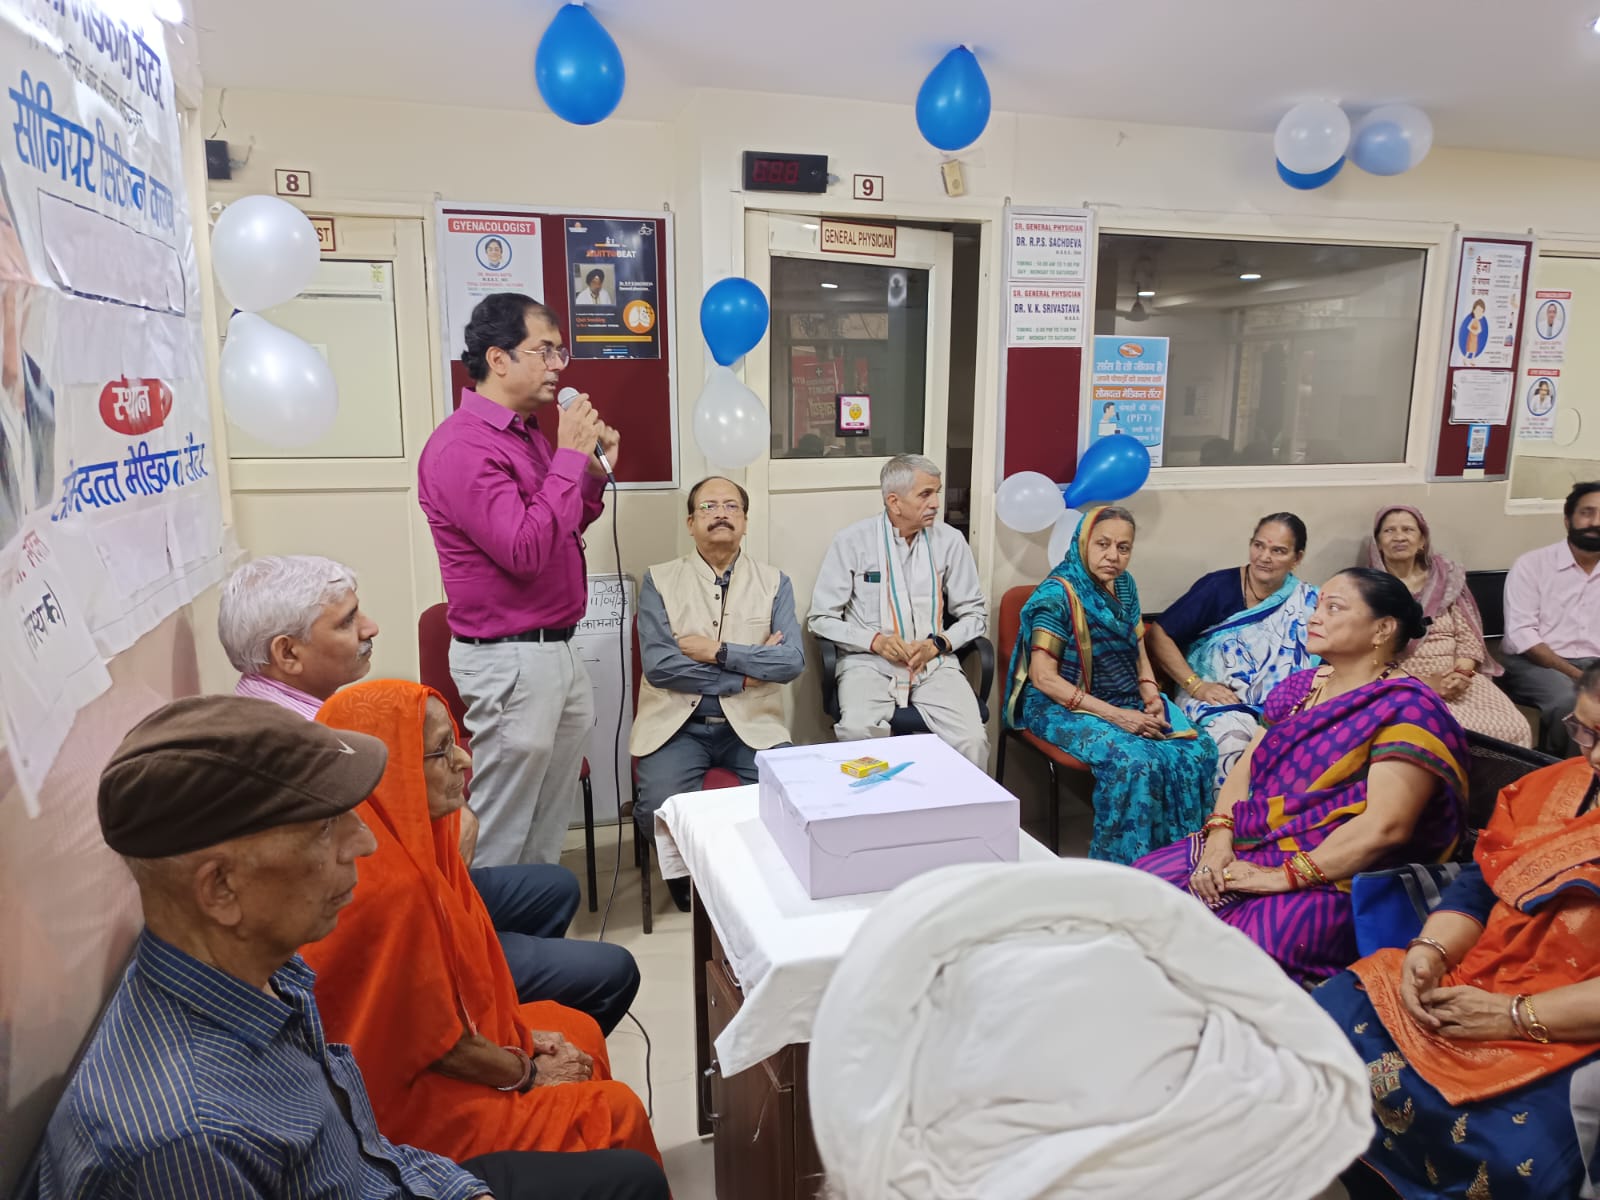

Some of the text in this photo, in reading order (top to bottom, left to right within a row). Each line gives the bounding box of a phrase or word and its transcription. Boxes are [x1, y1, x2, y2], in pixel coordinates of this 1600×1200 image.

[286, 174, 299, 192] 8
[862, 178, 874, 196] 9
[452, 220, 531, 233] GYENACOLOGIST
[1053, 224, 1083, 232] PHYSICIAN
[824, 229, 893, 249] GENERAL PHYSICIAN
[1016, 236, 1027, 246] DR.
[1049, 238, 1082, 248] SACHDEVA
[1014, 303, 1026, 313] DR.
[1043, 303, 1080, 313] SRIVASTAVA
[1127, 414, 1152, 423] (PFT)
